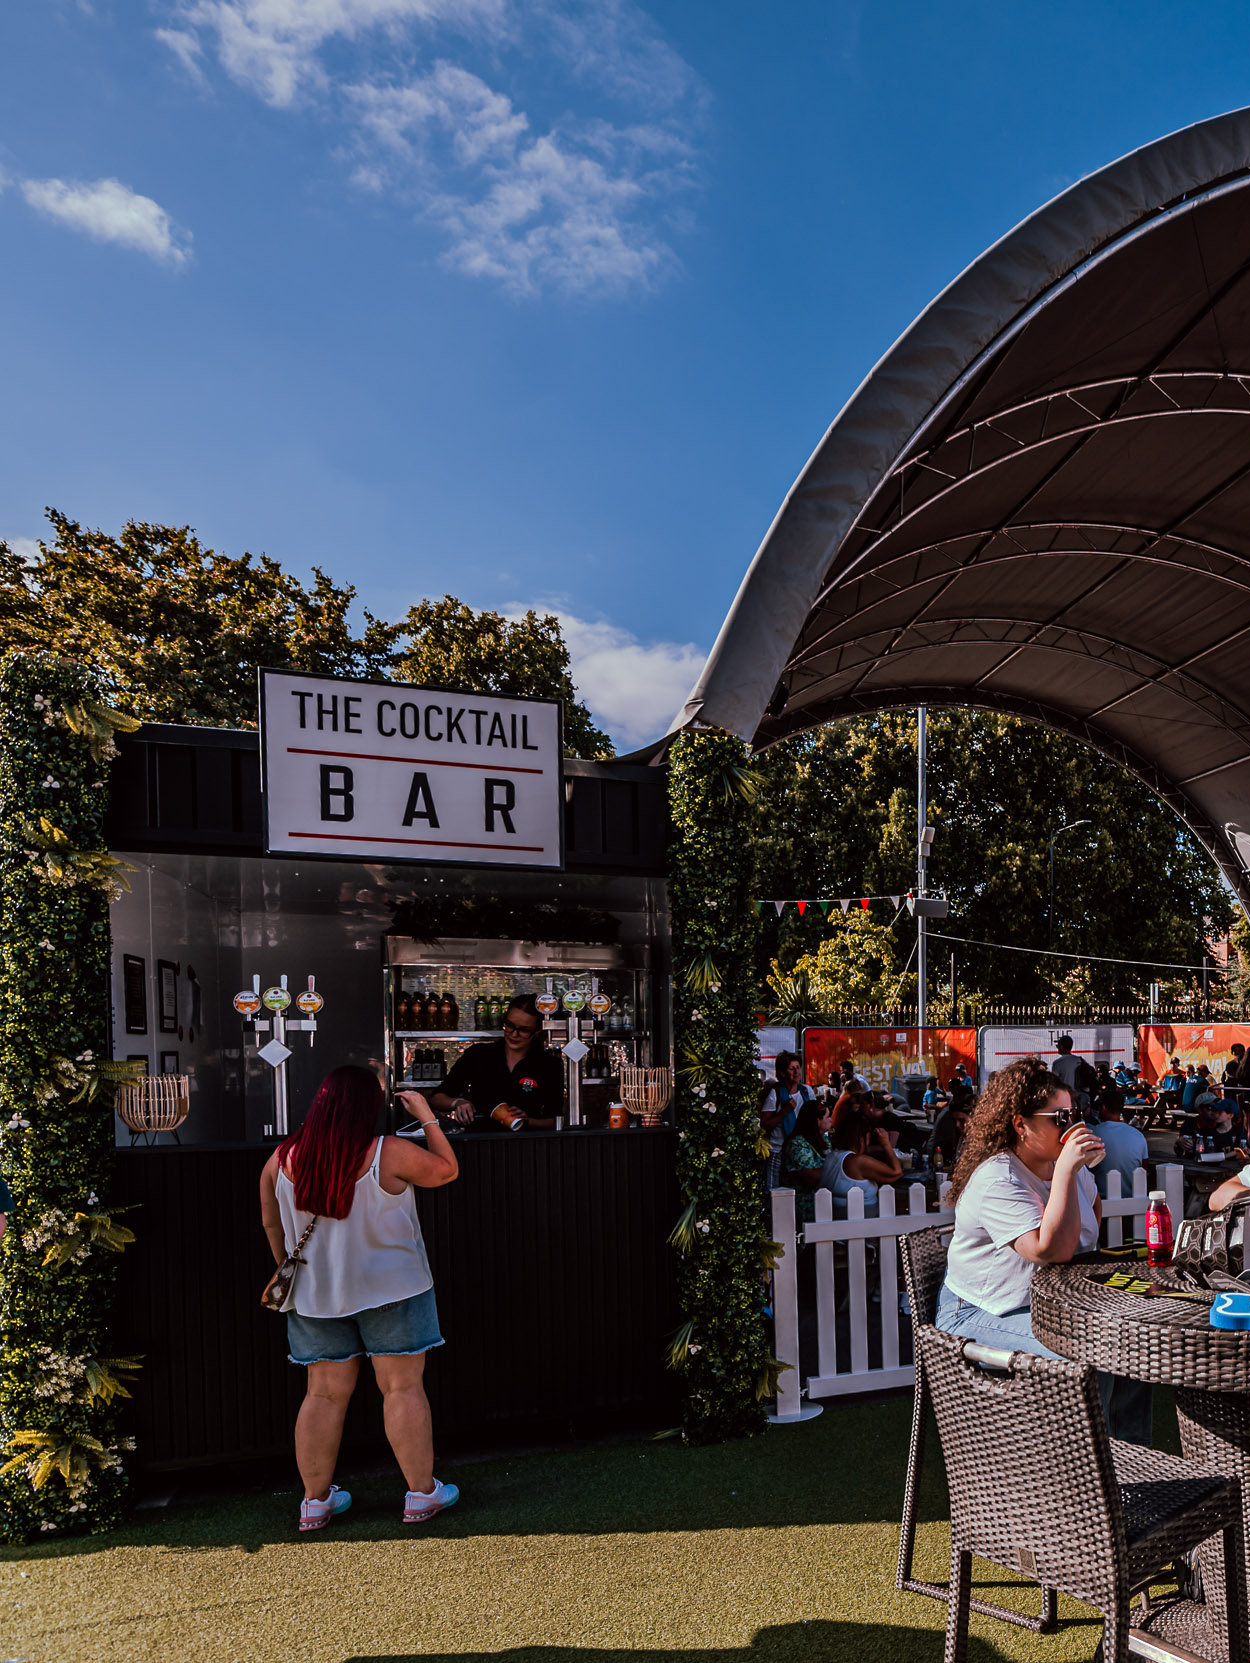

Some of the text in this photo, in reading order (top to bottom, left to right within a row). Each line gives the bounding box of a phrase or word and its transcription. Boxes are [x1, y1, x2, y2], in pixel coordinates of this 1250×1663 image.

[291, 690, 539, 751] THE COCKTAIL
[320, 764, 517, 834] BAR
[1048, 1030, 1073, 1047] TH
[1103, 1271, 1134, 1288] NOT
[1124, 1279, 1154, 1294] OUT
